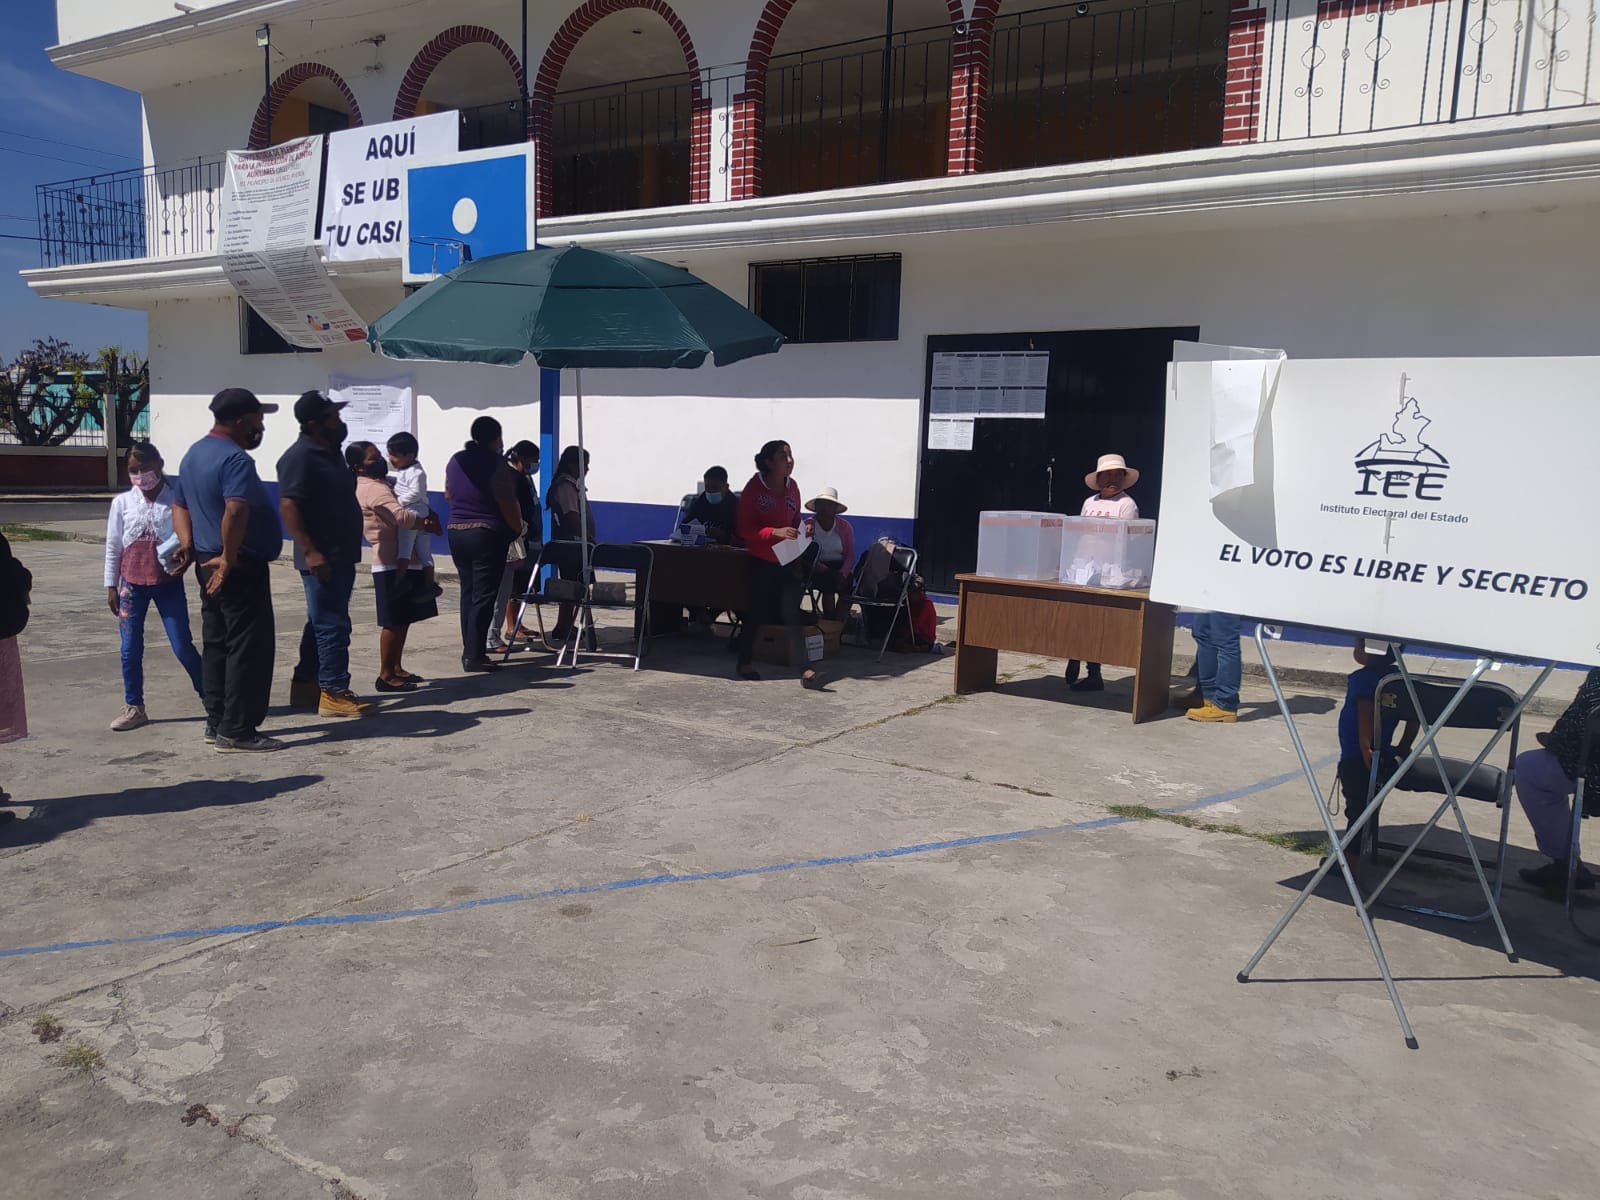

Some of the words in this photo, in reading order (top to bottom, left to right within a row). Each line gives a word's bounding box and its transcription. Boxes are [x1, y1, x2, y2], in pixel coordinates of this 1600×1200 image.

[365, 125, 415, 161] AQUÍ
[341, 182, 366, 206] SE
[326, 225, 351, 247] TU
[1354, 469, 1448, 501] IEE
[1320, 503, 1361, 516] Instituto
[1410, 510, 1428, 521] del
[1430, 512, 1469, 524] Estado
[1219, 543, 1242, 562] EL
[1251, 546, 1314, 570] VOTO
[1319, 554, 1347, 574] ES
[1353, 557, 1428, 583] LIBRE
[1436, 565, 1455, 586] Y
[1458, 568, 1589, 601] SECRETO
